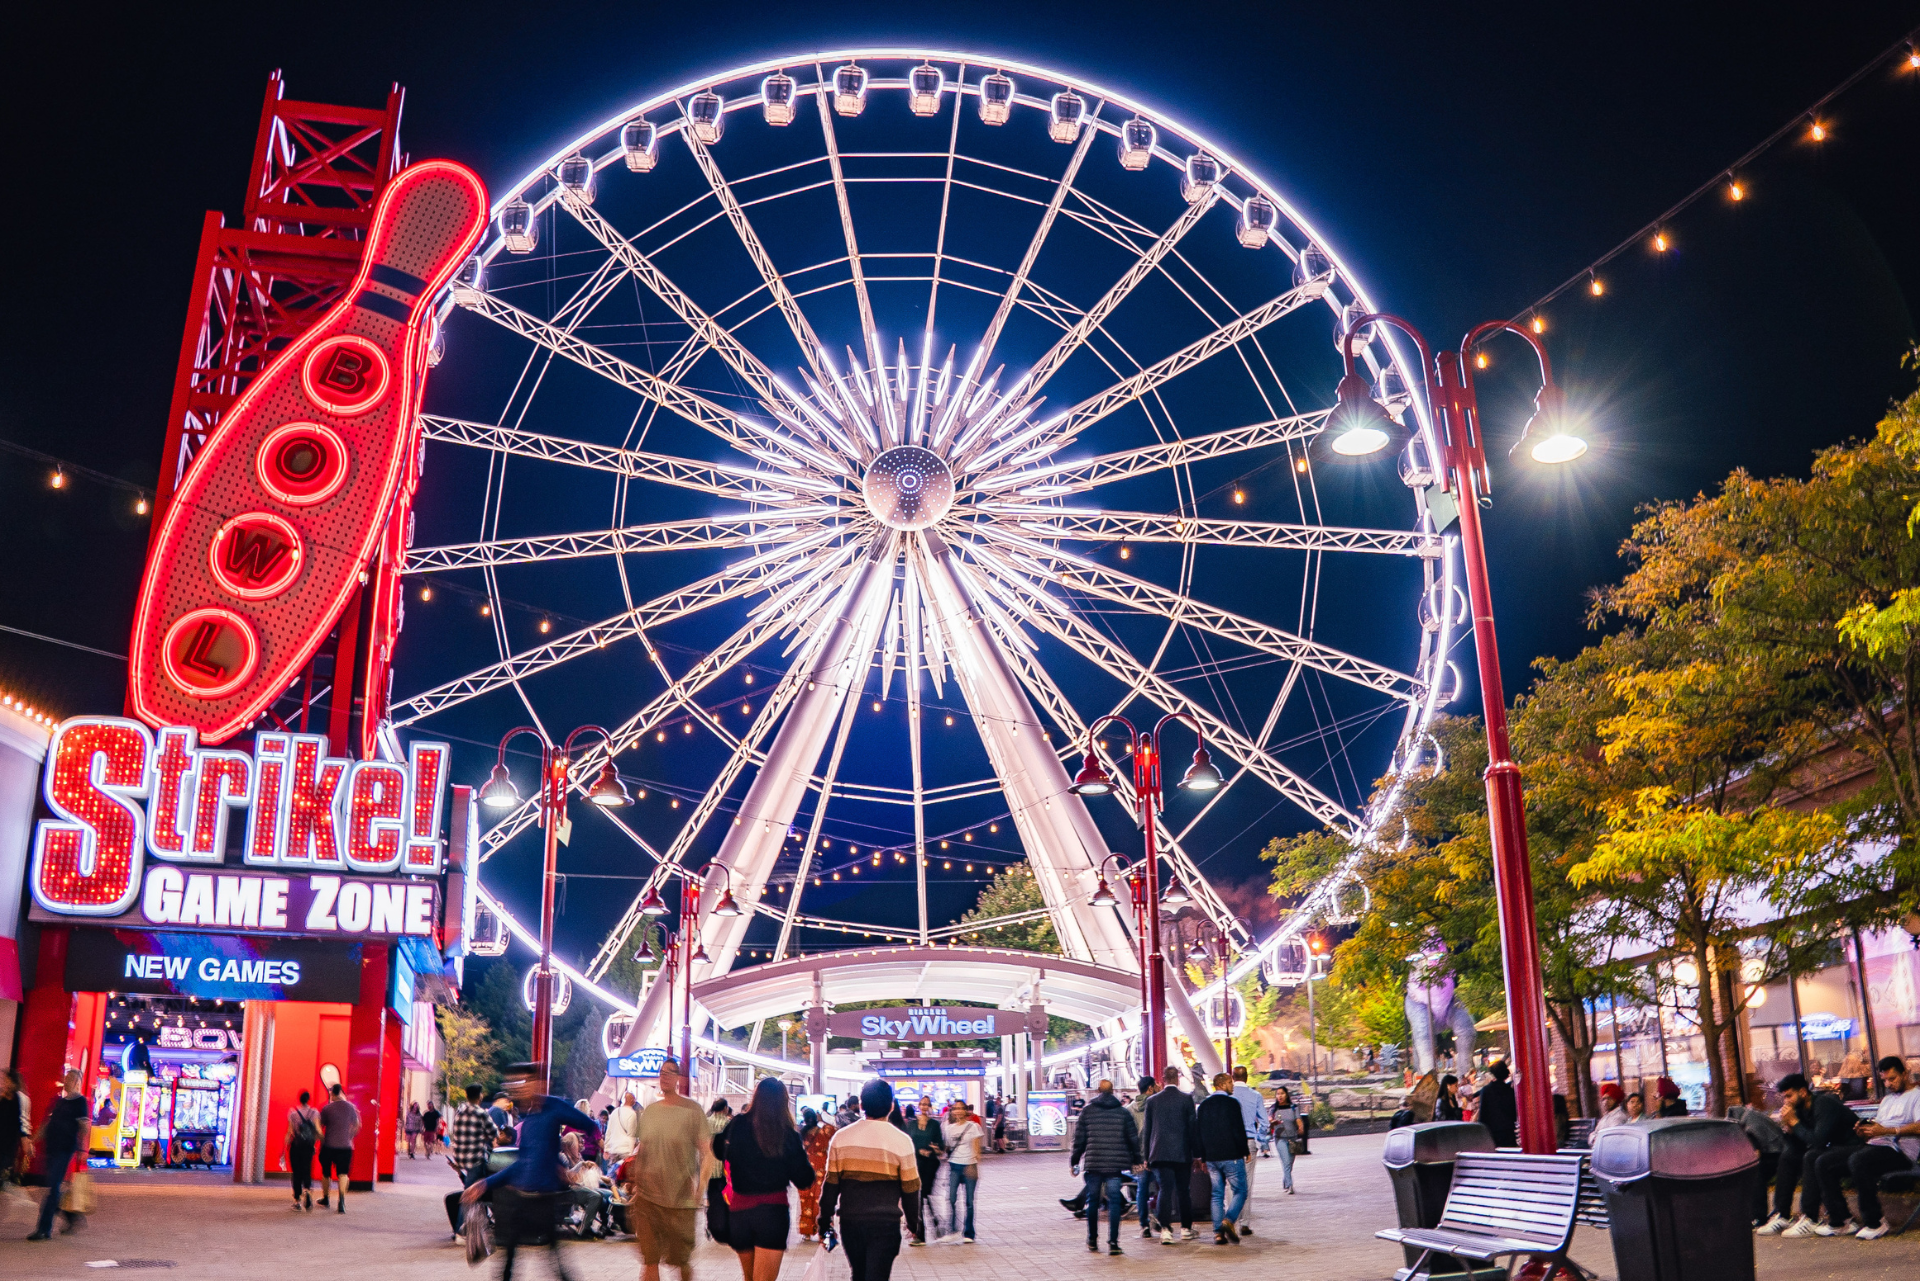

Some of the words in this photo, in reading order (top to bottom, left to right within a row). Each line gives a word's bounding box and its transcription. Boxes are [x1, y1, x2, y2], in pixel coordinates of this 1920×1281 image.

[30, 715, 450, 917] Strike!
[143, 866, 289, 930] GAME
[305, 875, 434, 935] ZONE
[124, 954, 192, 980] NEW
[198, 956, 300, 986] GAMES
[861, 1015, 995, 1039] SkyWheel
